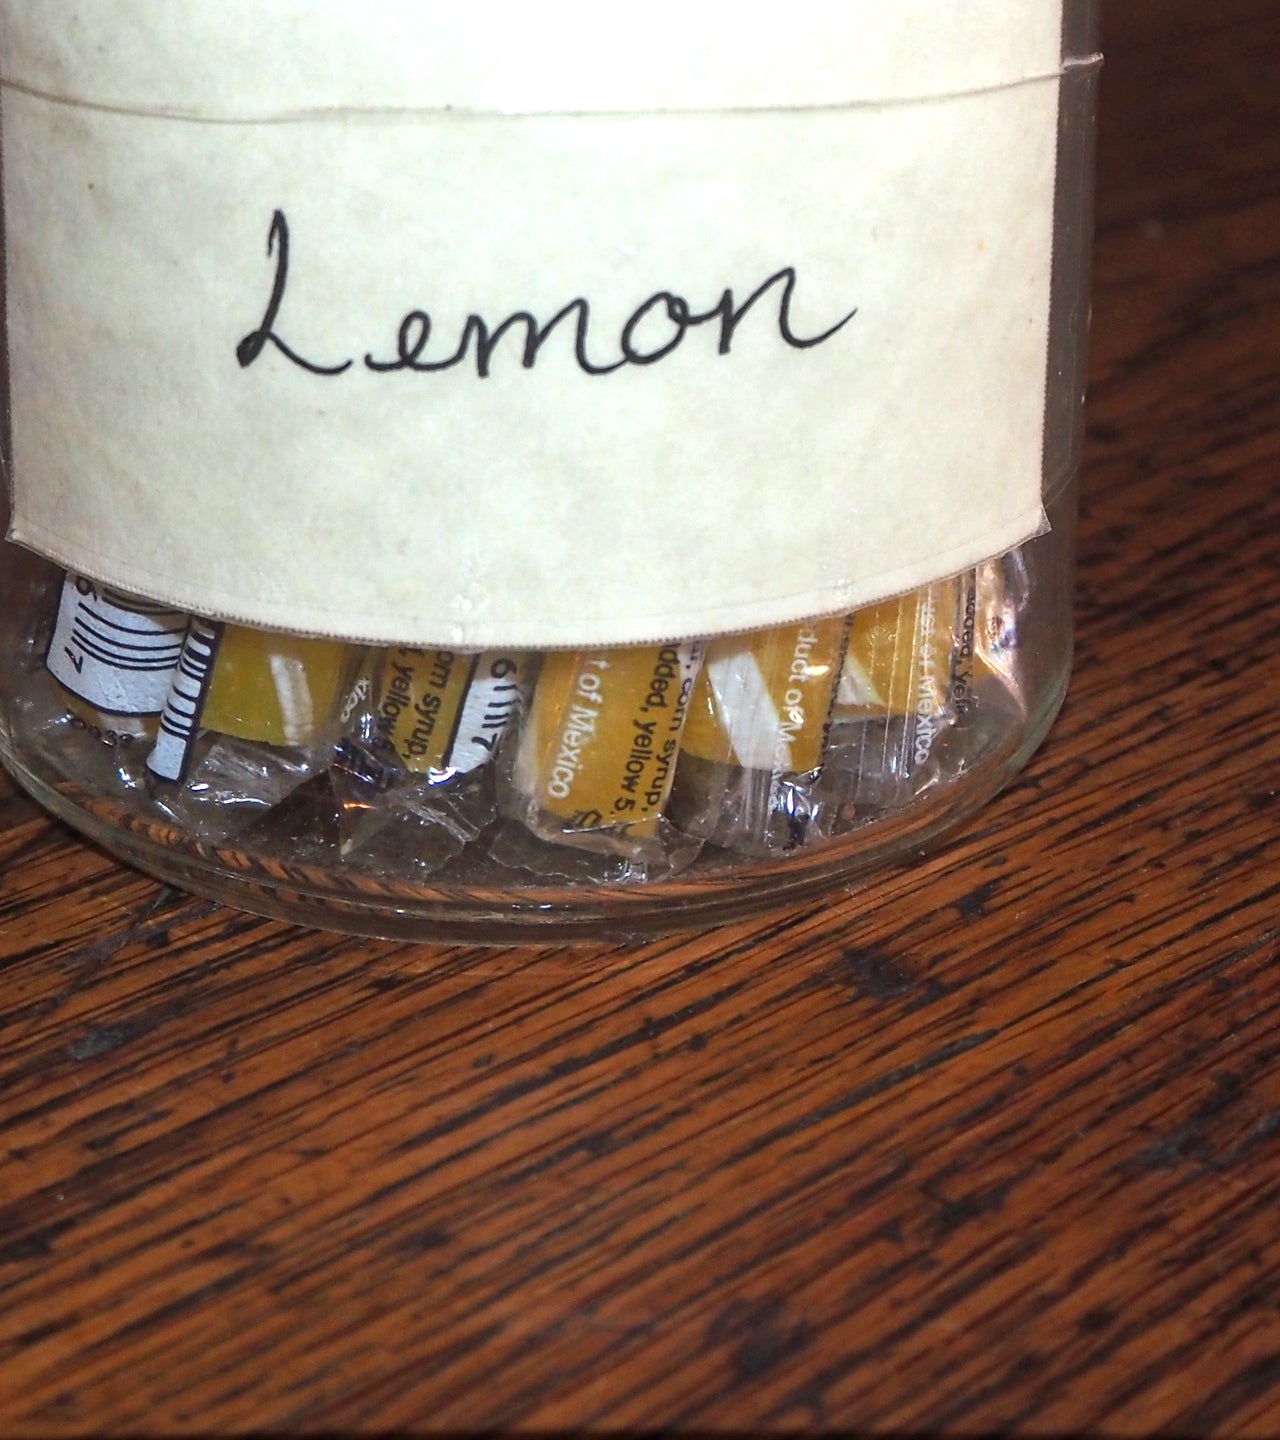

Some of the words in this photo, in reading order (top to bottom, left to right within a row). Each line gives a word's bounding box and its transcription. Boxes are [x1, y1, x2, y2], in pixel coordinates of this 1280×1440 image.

[236, 208, 858, 378] Lemon
[577, 673, 603, 704] of
[402, 693, 441, 759] syrup,
[547, 705, 599, 798] Mexico
[621, 720, 657, 792] yellow
